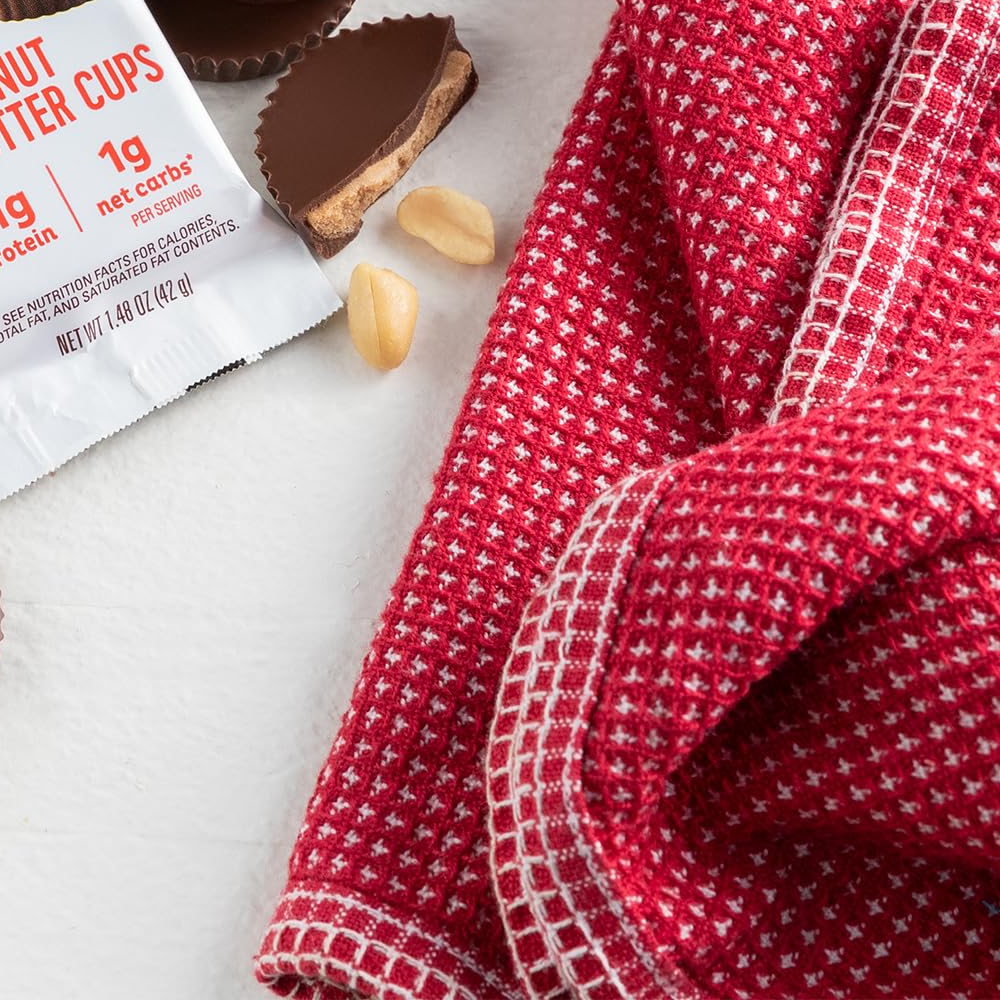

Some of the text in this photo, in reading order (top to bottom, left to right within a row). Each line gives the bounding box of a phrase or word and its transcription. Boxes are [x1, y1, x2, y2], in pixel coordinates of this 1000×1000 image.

[73, 43, 164, 110] CUPS
[97, 135, 151, 173] 1g
[96, 187, 134, 216] net
[131, 184, 202, 227] PER SERVING
[2, 214, 217, 326] SEE NUTRITION FACTS FOR CALORIES,
[27, 310, 51, 328] FAT,
[53, 296, 80, 317] AND
[82, 261, 148, 303] SATURATED
[150, 250, 170, 268] FAT
[173, 219, 240, 257] CONTENTS.
[56, 272, 194, 356] NET WT 1.48 OZ (42 g)
